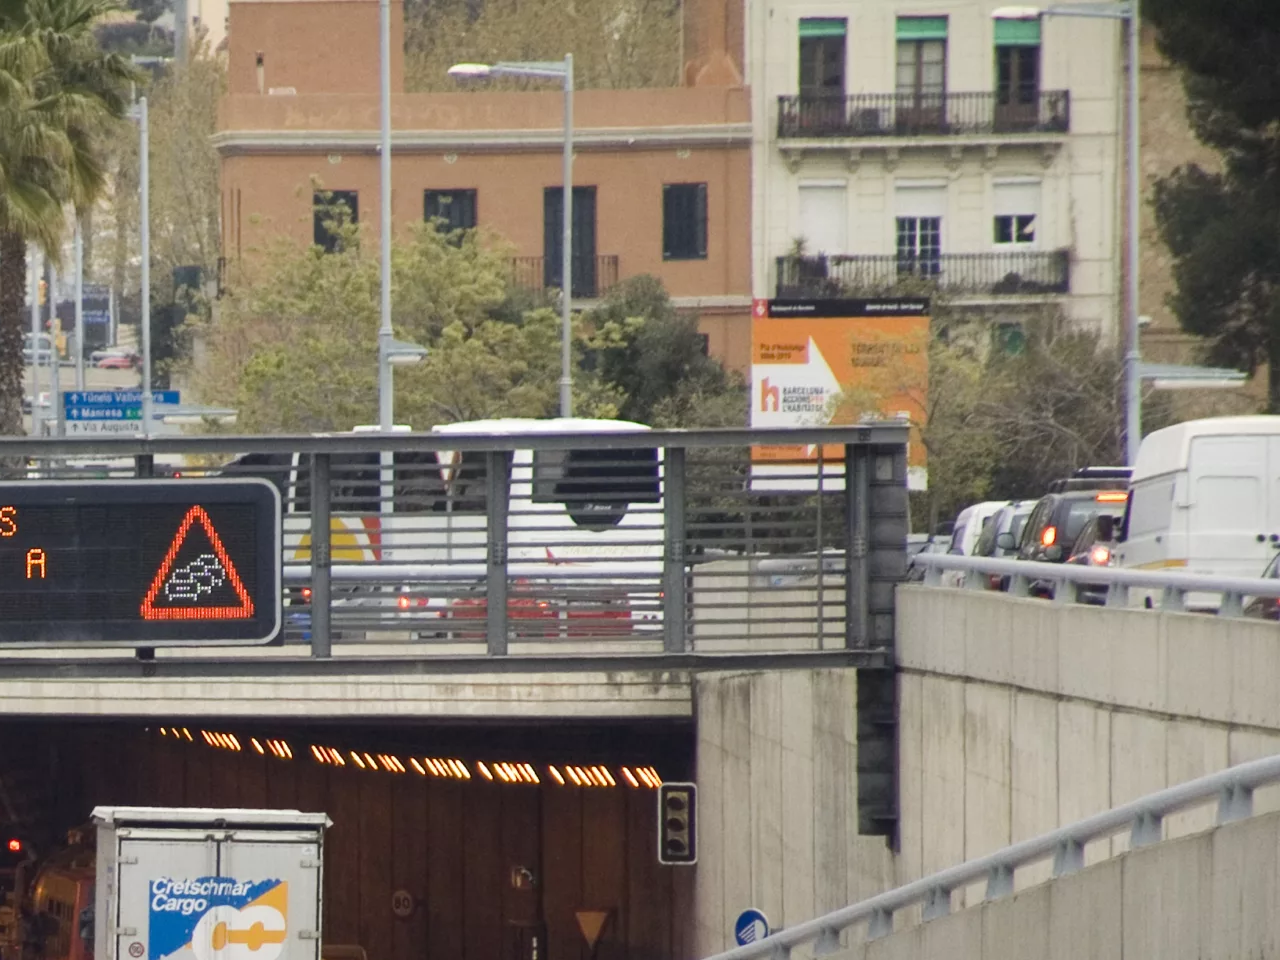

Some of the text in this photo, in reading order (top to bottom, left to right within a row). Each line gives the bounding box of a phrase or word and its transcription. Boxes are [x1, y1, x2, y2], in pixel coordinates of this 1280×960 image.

[83, 422, 139, 432] Via Augusta
[26, 549, 46, 579] A
[152, 877, 252, 896] Cretschmar
[151, 896, 207, 915] Cargo
